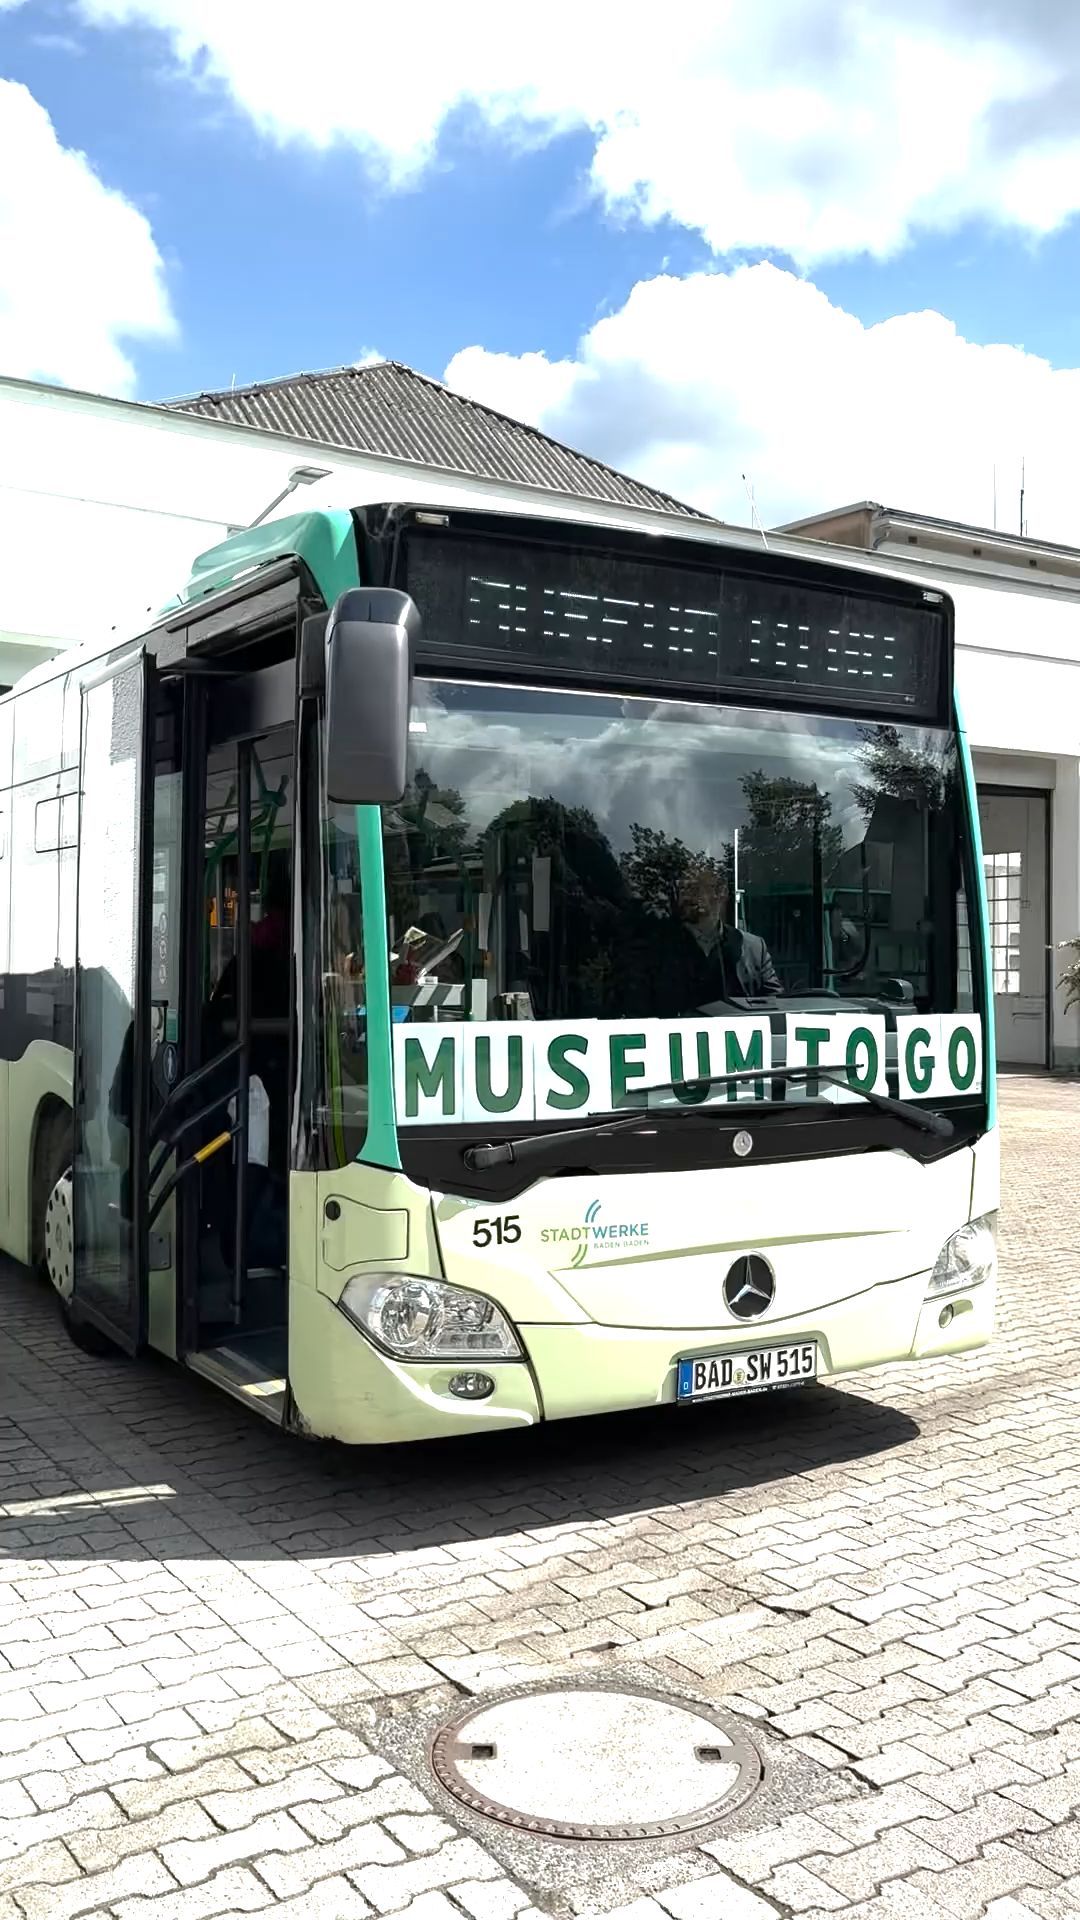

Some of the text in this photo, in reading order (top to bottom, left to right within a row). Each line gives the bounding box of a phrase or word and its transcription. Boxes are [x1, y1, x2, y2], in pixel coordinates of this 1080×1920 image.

[404, 1025, 977, 1118] MUSEUM TO GO
[472, 1215, 522, 1248] 515
[540, 1222, 649, 1243] STADTWERKE
[695, 1346, 813, 1391] BAD SW 515
[683, 1381, 689, 1391] D
